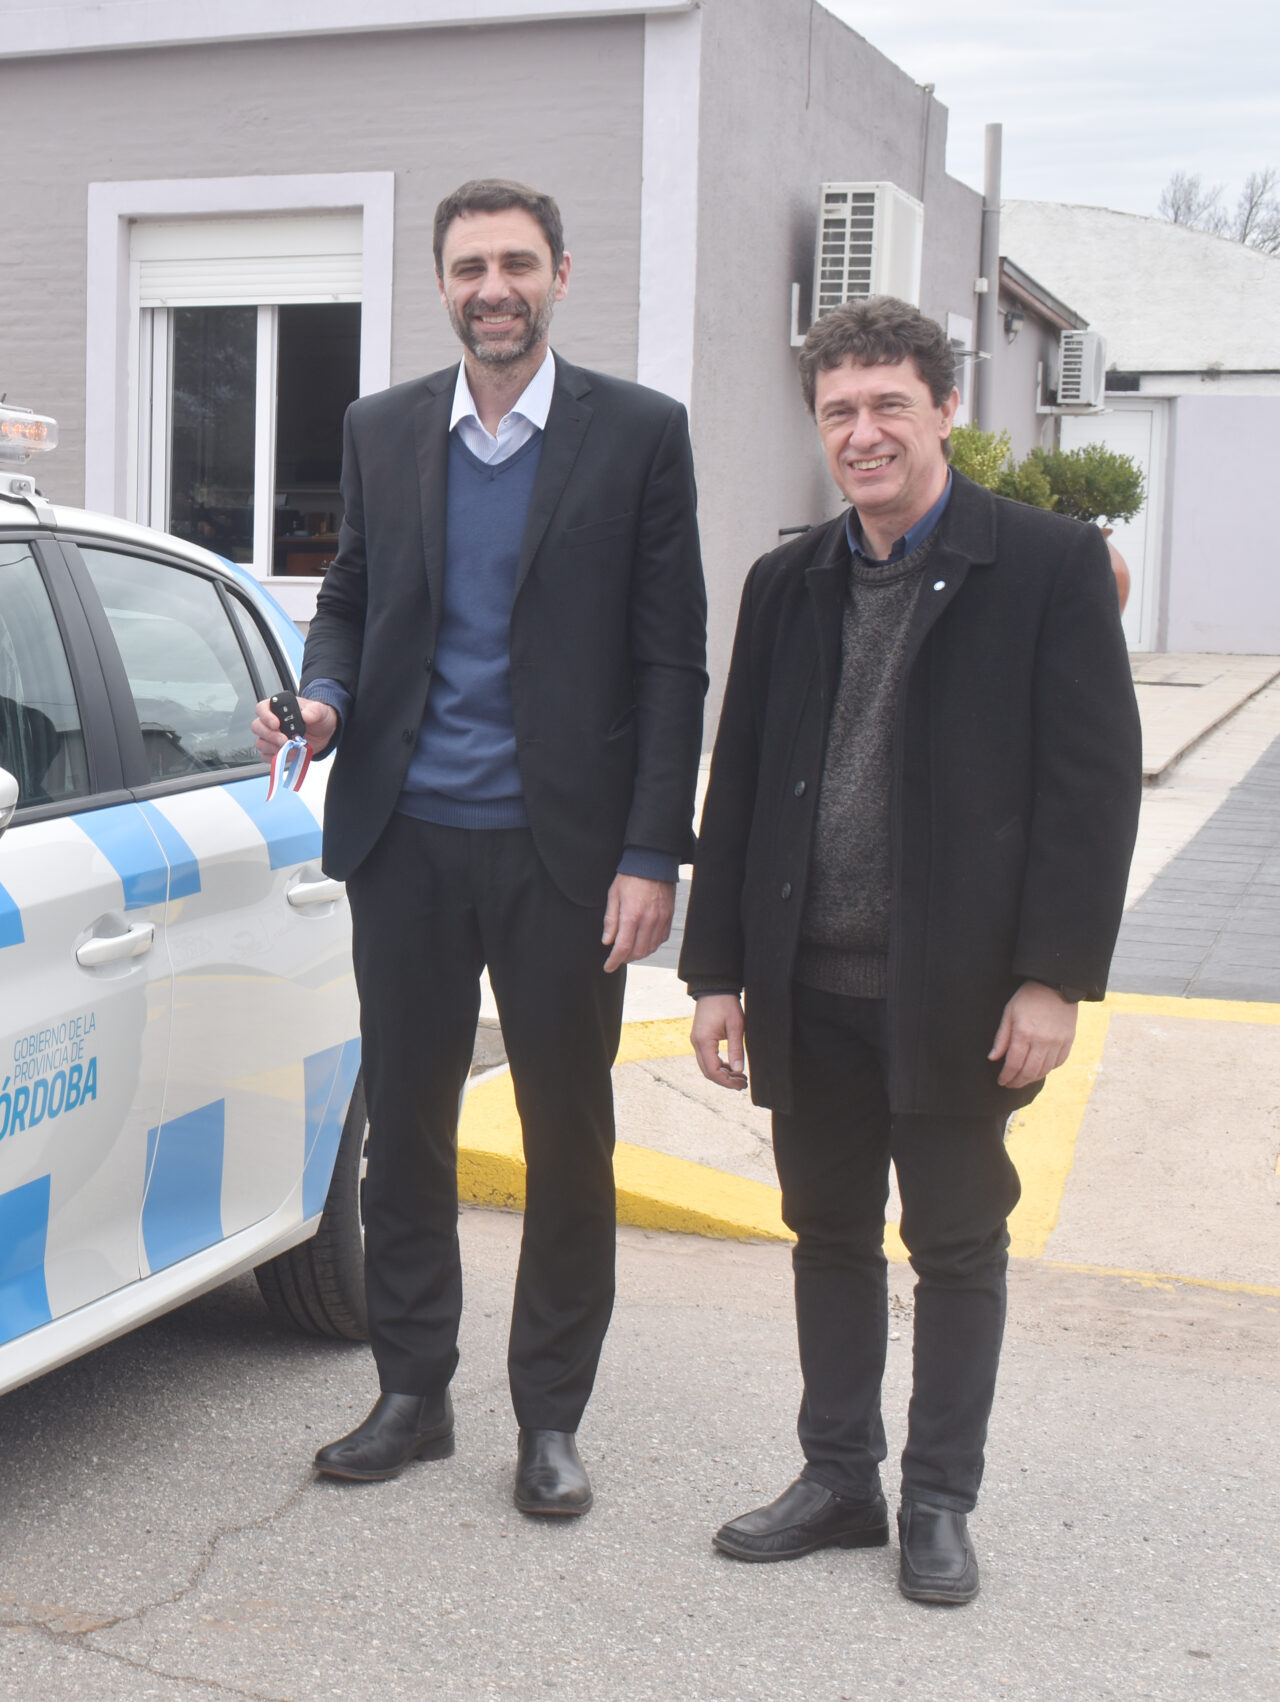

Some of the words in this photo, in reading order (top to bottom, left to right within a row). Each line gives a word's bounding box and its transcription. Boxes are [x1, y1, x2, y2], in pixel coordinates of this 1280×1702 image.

[14, 1023, 67, 1062] GOBIERNO
[69, 1017, 83, 1041] DE
[84, 1012, 95, 1035] LA
[13, 1048, 69, 1086] PROVINCIA
[70, 1039, 85, 1062] DE
